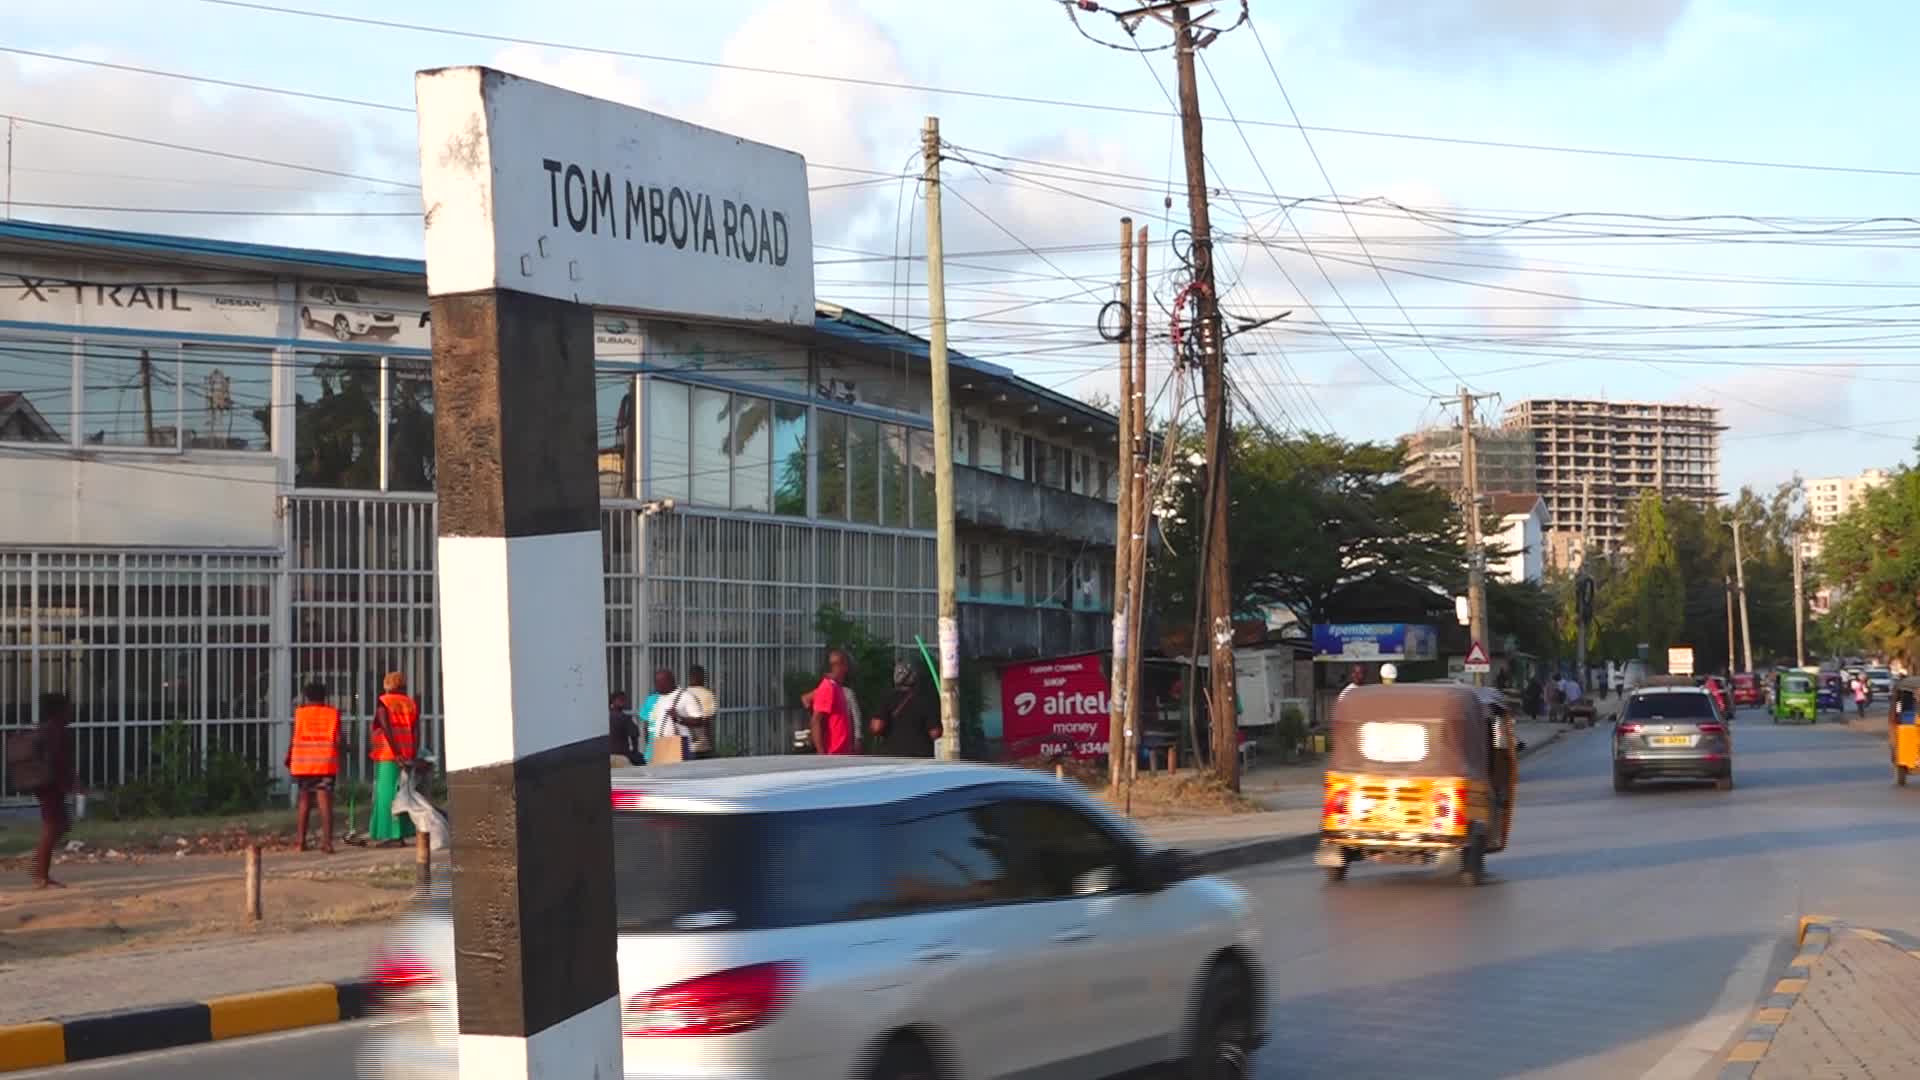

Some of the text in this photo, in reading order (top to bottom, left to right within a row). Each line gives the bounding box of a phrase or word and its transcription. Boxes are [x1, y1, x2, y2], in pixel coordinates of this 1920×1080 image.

[543, 158, 789, 267] TOM MBOYA ROAD
[18, 275, 192, 312] X-TRAIL
[596, 335, 639, 346] SUBARU
[1043, 691, 1107, 715] airtel
[1053, 722, 1098, 737] money
